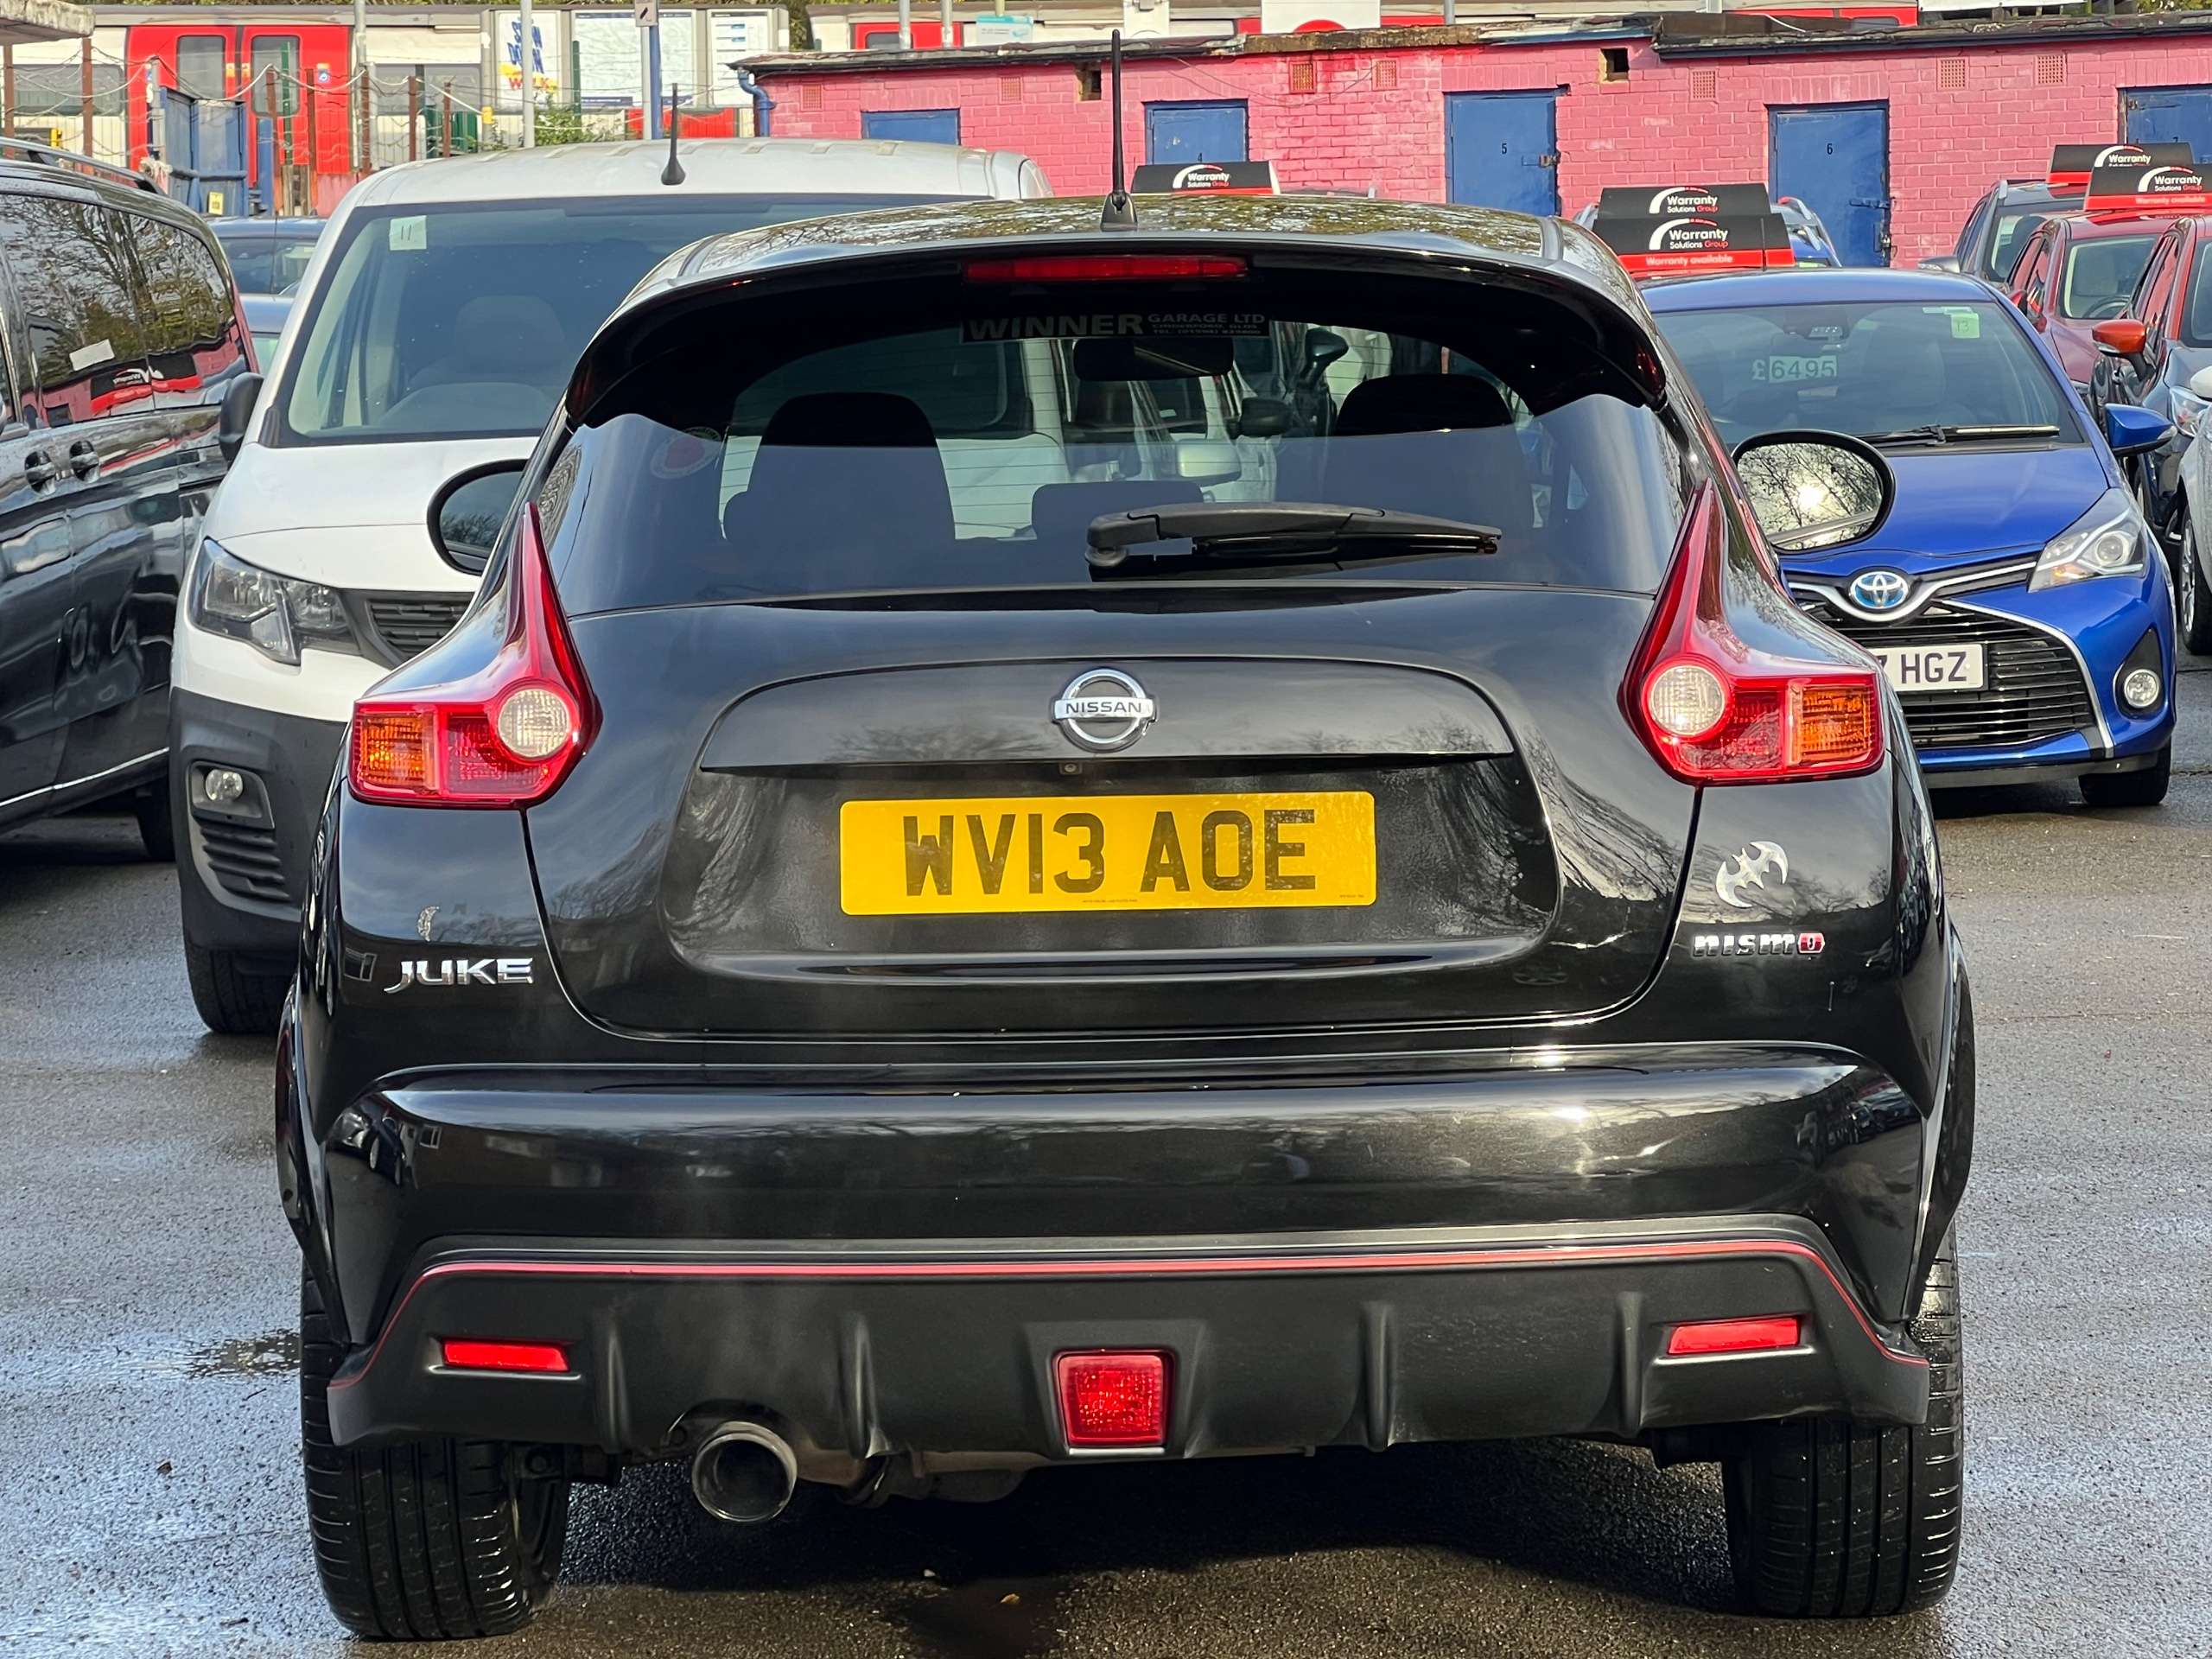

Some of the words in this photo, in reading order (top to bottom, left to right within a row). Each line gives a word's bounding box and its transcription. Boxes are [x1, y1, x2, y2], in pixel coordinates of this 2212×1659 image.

[1501, 143, 1508, 155] 5
[1827, 143, 1834, 155] 6
[2108, 154, 2152, 164] Warranty
[1187, 173, 1230, 183] Warranty
[2154, 175, 2202, 186] Warranty
[1667, 194, 1719, 207] Warranty
[1696, 205, 1719, 213] Group
[1669, 229, 1729, 242] Warranty
[1669, 241, 1703, 250] Solutions
[1704, 239, 1729, 249] Group
[1646, 257, 1688, 267] Warranty
[1689, 254, 1733, 264] available
[968, 313, 1144, 340] WINNER
[1147, 313, 1228, 324] GARAGE
[1234, 313, 1266, 324] LTD
[1900, 651, 1967, 684] HGZ
[1065, 701, 1141, 715] NISSAN
[902, 811, 1105, 897] WV13
[1140, 808, 1317, 893] AOE
[384, 957, 534, 994] JUKE
